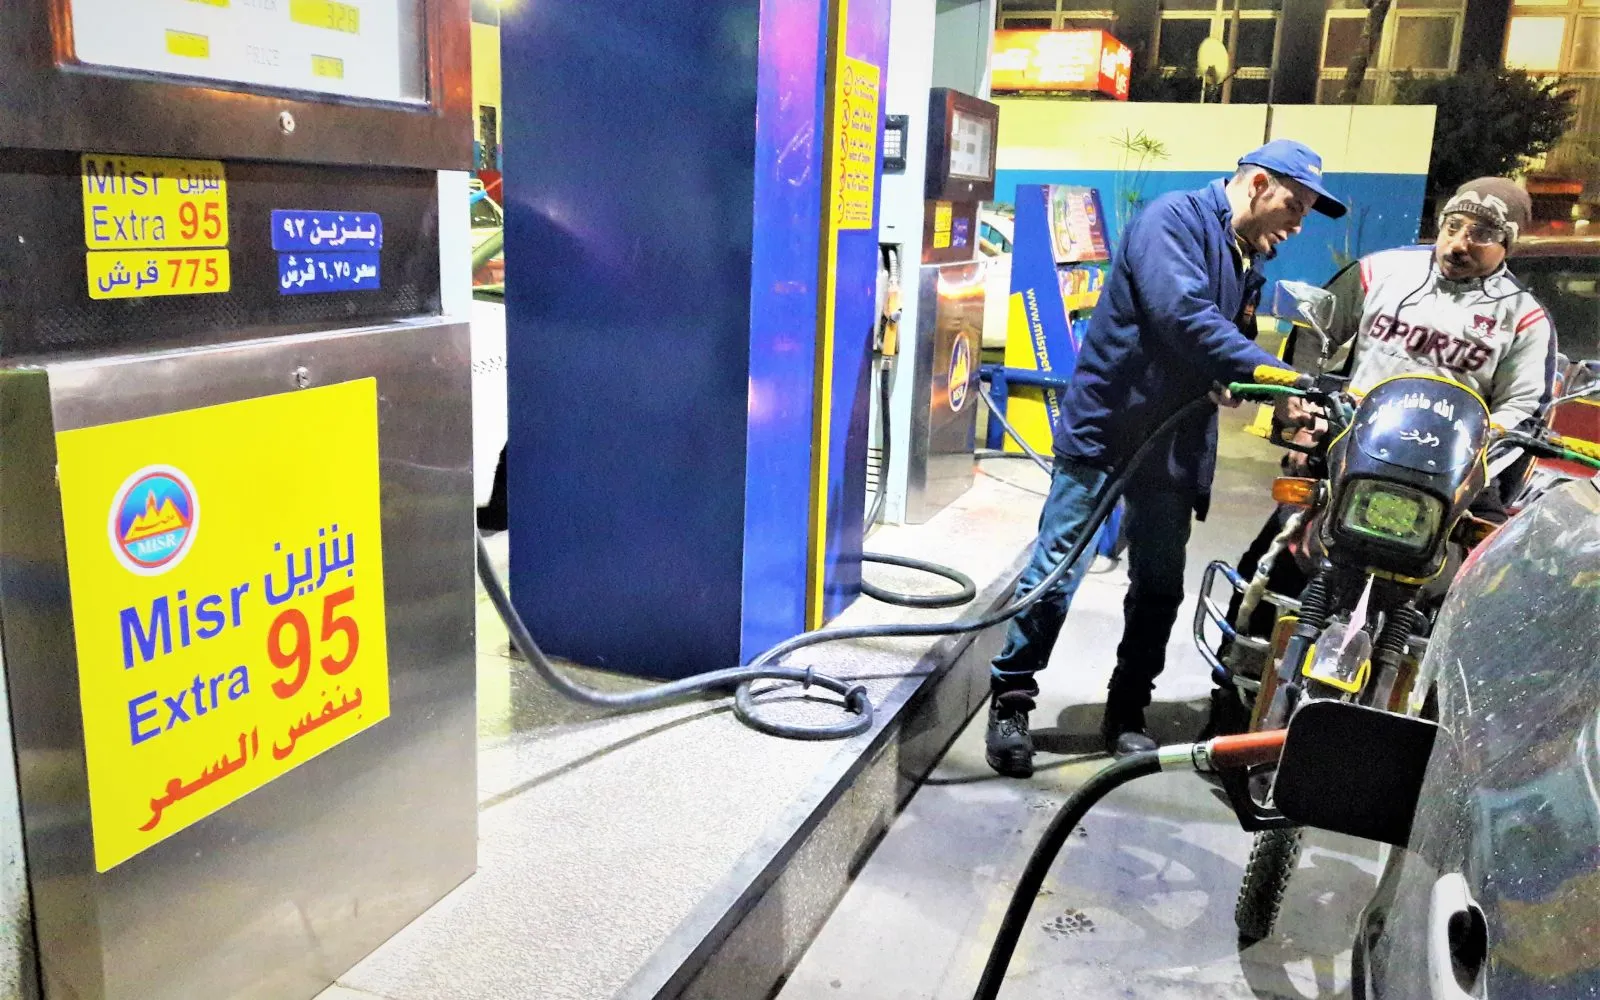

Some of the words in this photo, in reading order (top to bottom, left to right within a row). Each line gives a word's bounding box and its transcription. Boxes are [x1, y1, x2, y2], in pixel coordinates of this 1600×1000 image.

[85, 160, 163, 195] Misr
[177, 168, 219, 195] بنزين
[92, 205, 165, 241] Extra
[178, 201, 222, 240] 95
[283, 218, 305, 238] ٩٢
[309, 215, 376, 247] بنزين
[97, 260, 159, 292] قرش
[167, 258, 219, 288] 775
[281, 255, 316, 289] قرش
[352, 263, 377, 284] سعر
[1368, 312, 1495, 374] SPORTS
[137, 533, 177, 557] MISR
[119, 582, 250, 670] Misr
[264, 523, 356, 605] بنزين
[127, 666, 250, 746] Extra
[267, 586, 360, 701] 95
[271, 685, 363, 760] بنفس
[138, 726, 260, 832] السعر
